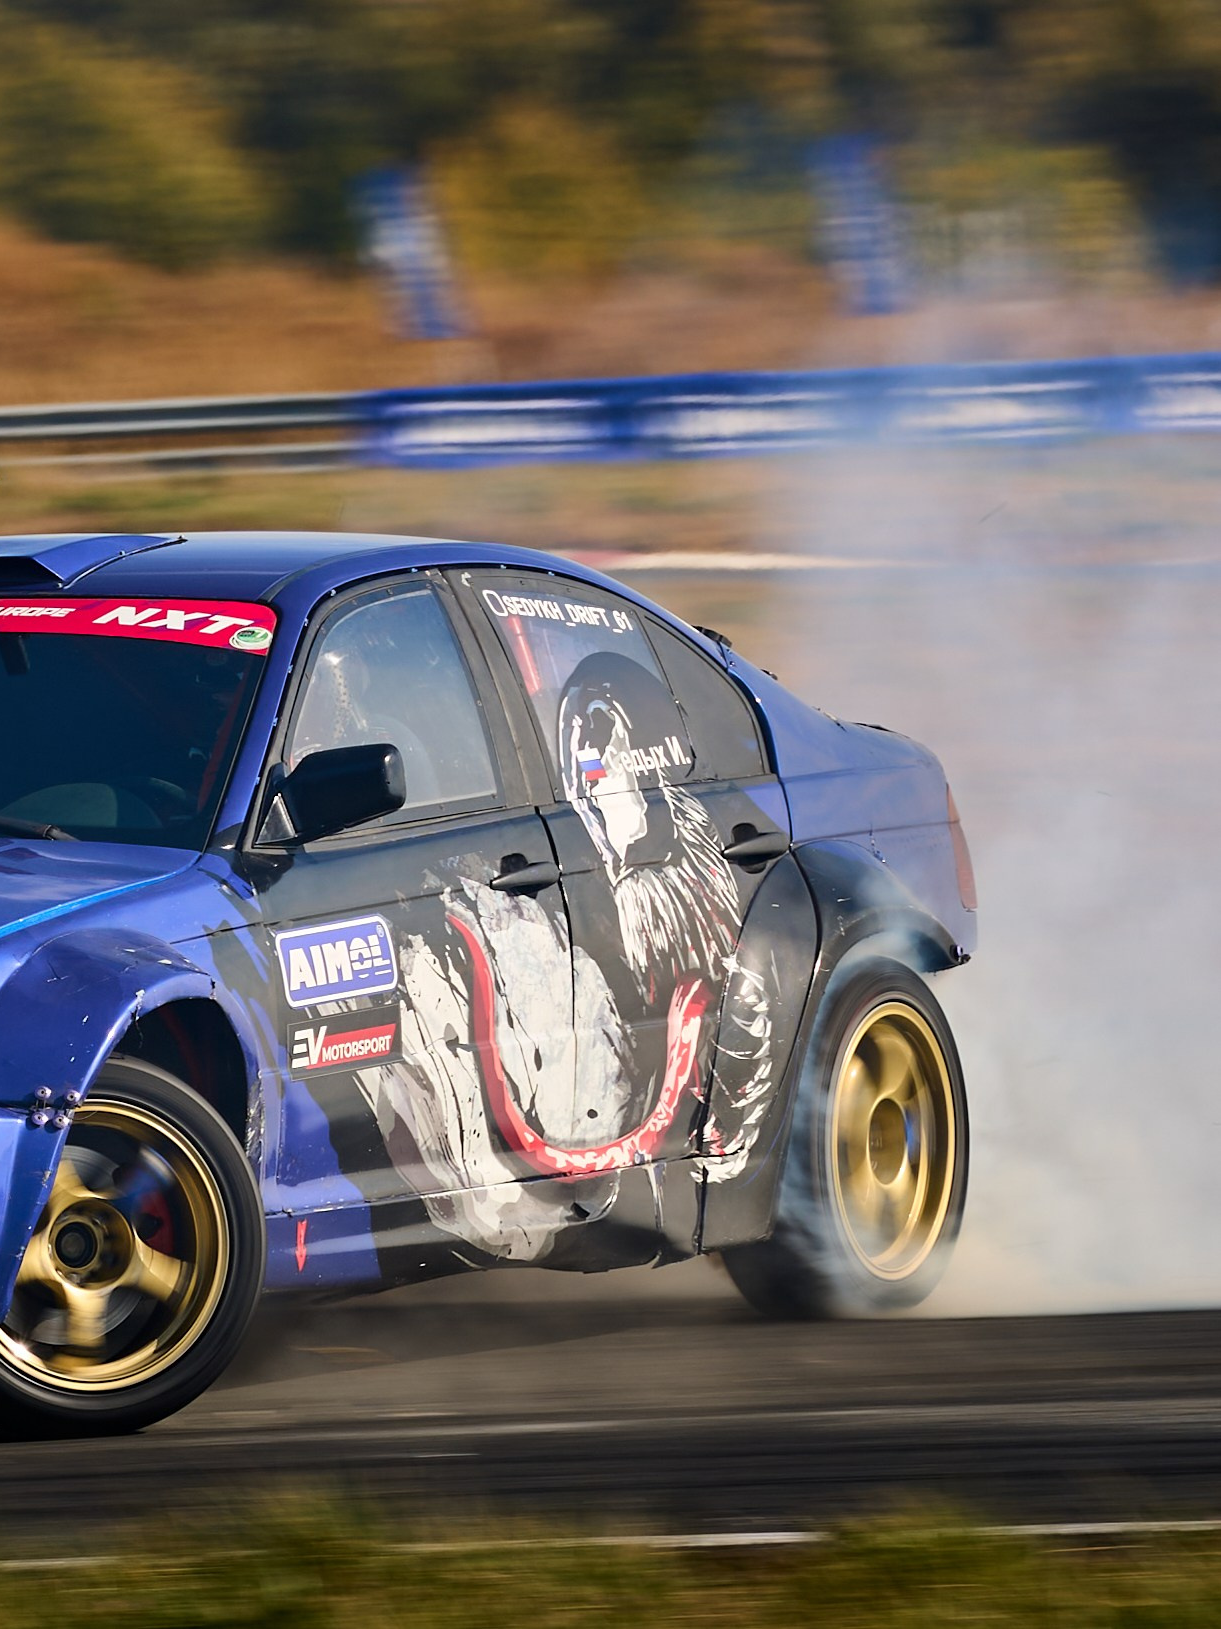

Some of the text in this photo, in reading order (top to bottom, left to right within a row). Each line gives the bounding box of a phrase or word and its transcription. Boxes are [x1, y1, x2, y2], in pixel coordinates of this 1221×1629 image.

[91, 605, 255, 635] NXT
[501, 595, 634, 634] SEDYKH_DRIFT_61
[605, 736, 692, 776] Седых И.
[289, 934, 392, 991] AIMOL
[322, 1035, 392, 1062] MOTORSPORT
